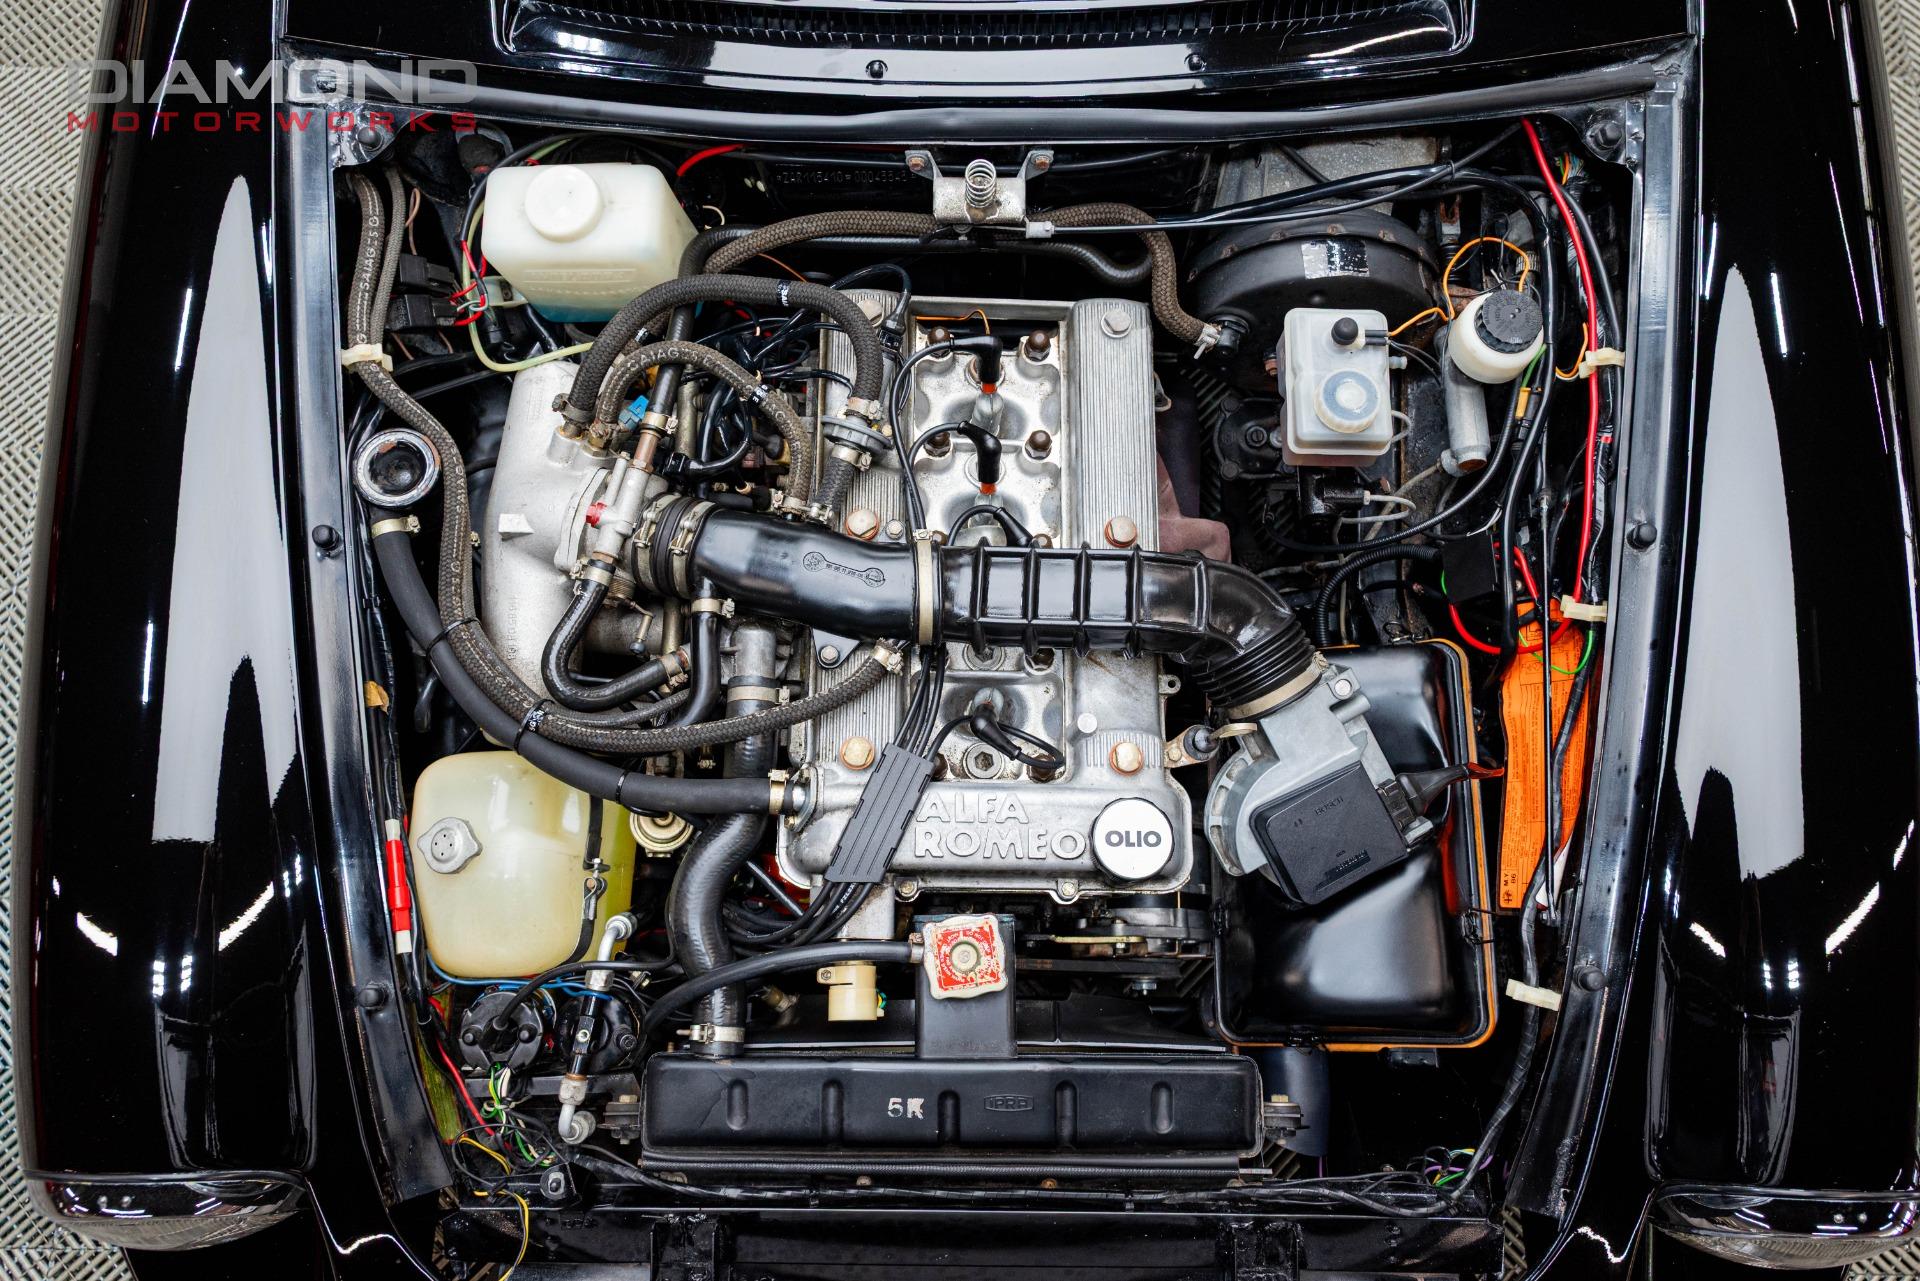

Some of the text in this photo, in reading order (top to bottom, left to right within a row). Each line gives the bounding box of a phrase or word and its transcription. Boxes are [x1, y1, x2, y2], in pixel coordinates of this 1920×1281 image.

[360, 247, 376, 291] SAIAG
[915, 791, 1030, 824] ALFA
[914, 825, 1087, 861] ROMEO
[1104, 829, 1162, 848] OLIO
